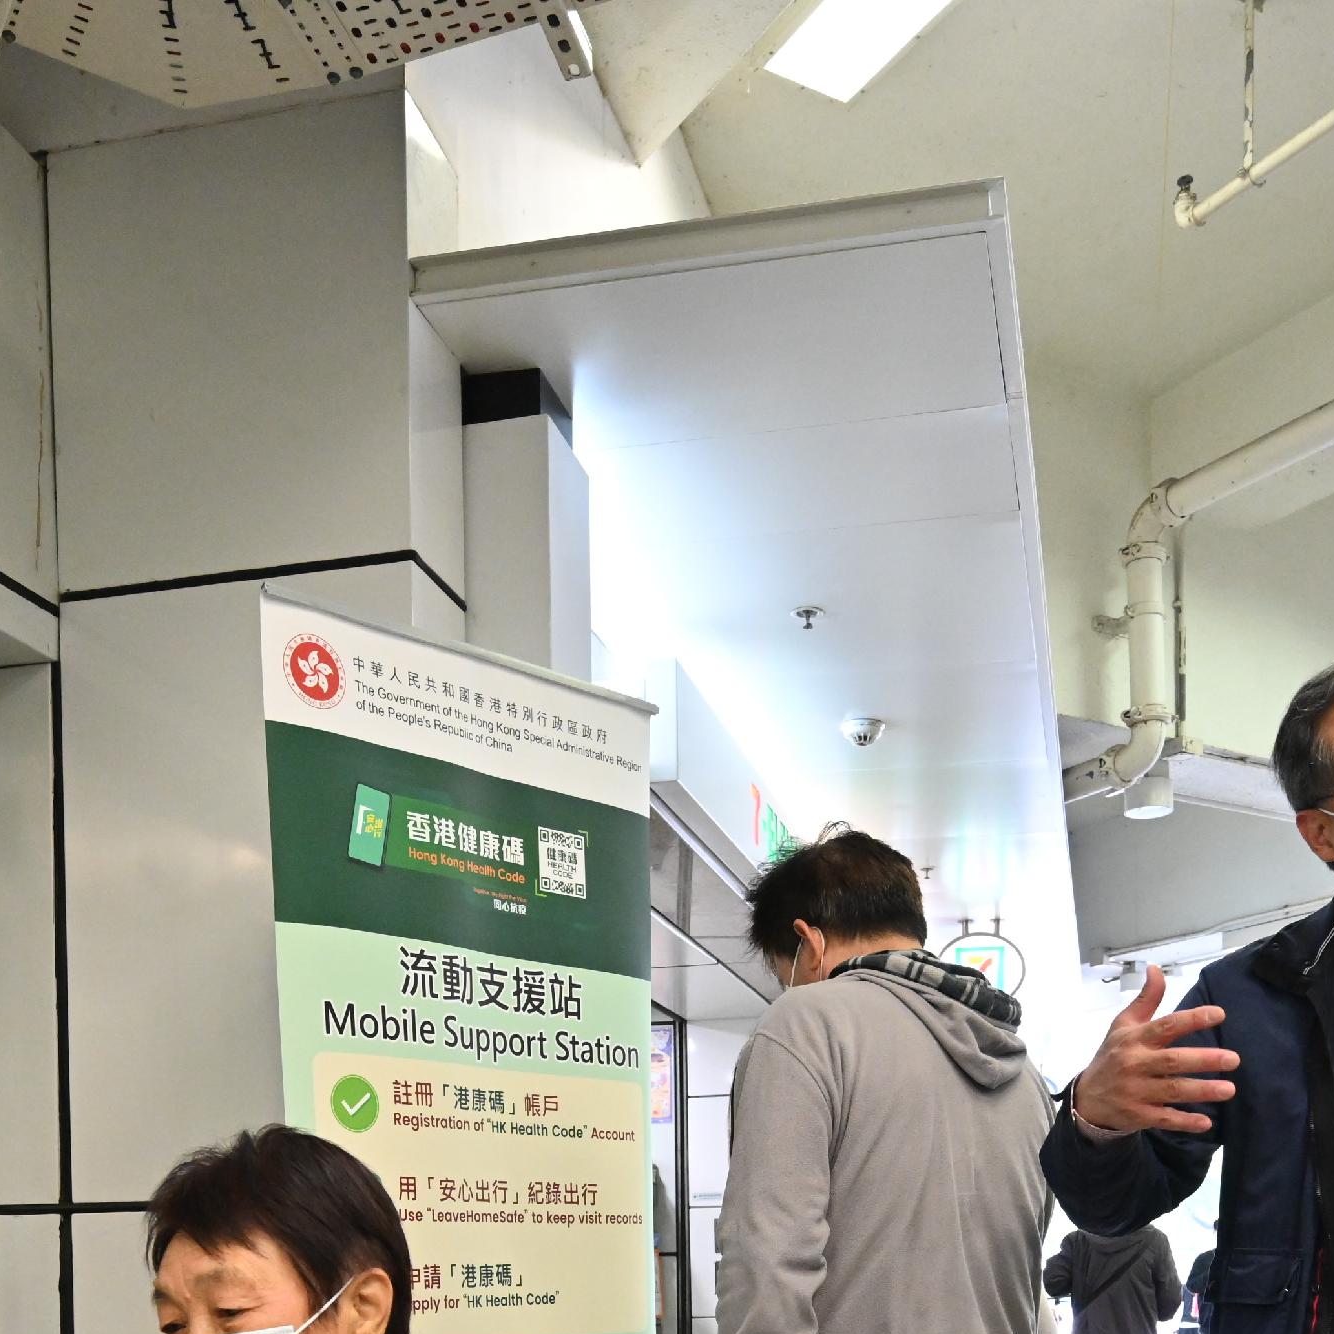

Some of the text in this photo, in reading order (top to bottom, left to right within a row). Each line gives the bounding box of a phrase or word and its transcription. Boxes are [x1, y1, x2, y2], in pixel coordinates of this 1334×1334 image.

[352, 655, 607, 745] 中華人民共和國香港特別行政區政府
[354, 679, 642, 774] The Government of the Hong Kong Special Administrative Region
[356, 700, 513, 753] of the People's Republic of China
[406, 810, 525, 867] 香港健康碼
[408, 846, 526, 885] Hong Kong Health Code
[399, 945, 582, 1021] 流動支援站
[323, 1000, 641, 1069] Mobile Support Station
[393, 1079, 560, 1117] 註冊「港康碼」帳戶
[393, 1112, 471, 1131] Registration
[473, 1118, 485, 1131] of
[510, 1122, 548, 1137] Health
[591, 1127, 636, 1142] Account
[399, 1176, 598, 1206] 用「安心出行」紀錄出行
[399, 1208, 424, 1222] Use
[531, 1211, 543, 1224] to
[546, 1211, 575, 1228] keep
[578, 1210, 603, 1225] visit
[605, 1211, 643, 1225] records
[412, 1297, 441, 1315] pply
[443, 1294, 460, 1309] for
[486, 1294, 523, 1308] Health
